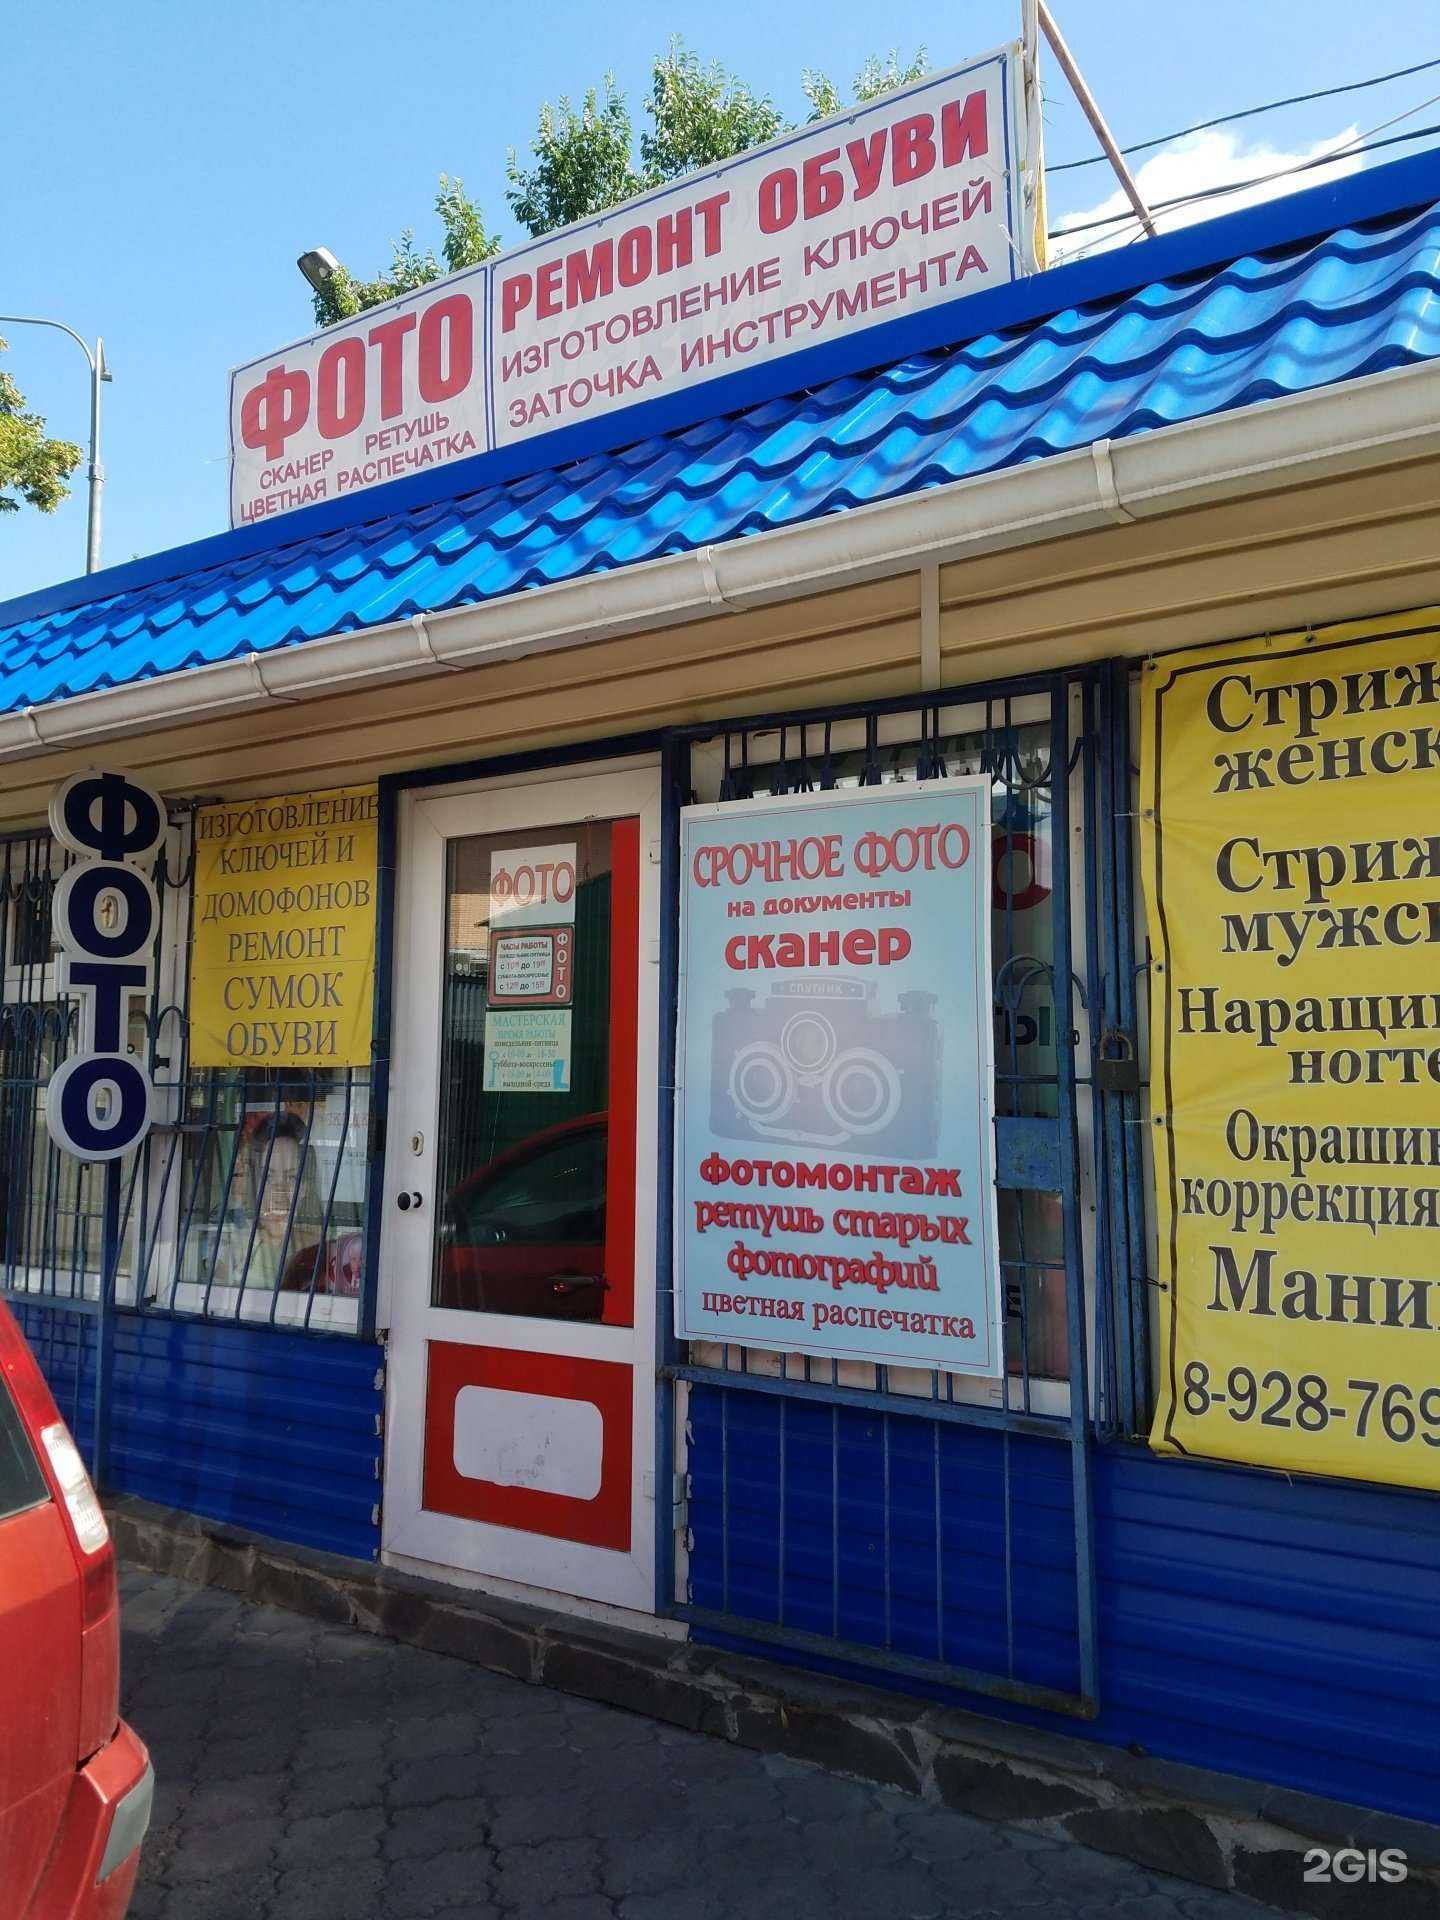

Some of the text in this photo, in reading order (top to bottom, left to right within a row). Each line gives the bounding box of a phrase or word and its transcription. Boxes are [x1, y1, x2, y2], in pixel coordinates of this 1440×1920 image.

[502, 89, 989, 333] РЕМОНТ ОБУВИ
[502, 176, 992, 382] ИЗГОТОВЛЕНИЕ КЛЮЧЕЙ
[509, 245, 989, 428] ЗАТОЧКА ИНСТРУМЕНТА
[241, 293, 473, 463] ФОТО
[240, 430, 477, 523] ЦВЕТНАЯ РАСПЕЧАТКА
[260, 411, 450, 490] СКАНЕР РЕТУШЬ
[1213, 726, 1440, 793] женск
[199, 795, 379, 839] ИЗГОТОВЛЕНИЕ
[220, 831, 355, 875] КЛЮЧЕЙ И
[693, 822, 971, 888] СРОЧНОЕ ФОТО
[202, 879, 370, 925] ДОМОФОНОВ
[492, 861, 575, 907] ФОТО
[727, 889, 912, 918] на документы
[60, 772, 161, 1152] ФОТО
[227, 925, 346, 962] РЕМОНТ
[556, 932, 569, 998] ФОТО
[725, 927, 911, 971] сканер
[224, 971, 343, 1010] СУМОК
[1178, 987, 1440, 1046] Наращи
[227, 1020, 339, 1056] ОБУВИ
[493, 1013, 565, 1028] МАСТЕРСКАЯ
[700, 1152, 963, 1197] фотомонтаж
[695, 1201, 972, 1248] ретушь старых
[1181, 1178, 1440, 1236] коррекция
[727, 1241, 941, 1293] фотографий
[1207, 1246, 1440, 1330] Мани
[702, 1291, 977, 1339] цветная распечатка
[1183, 1361, 1440, 1447] 8-928-769
